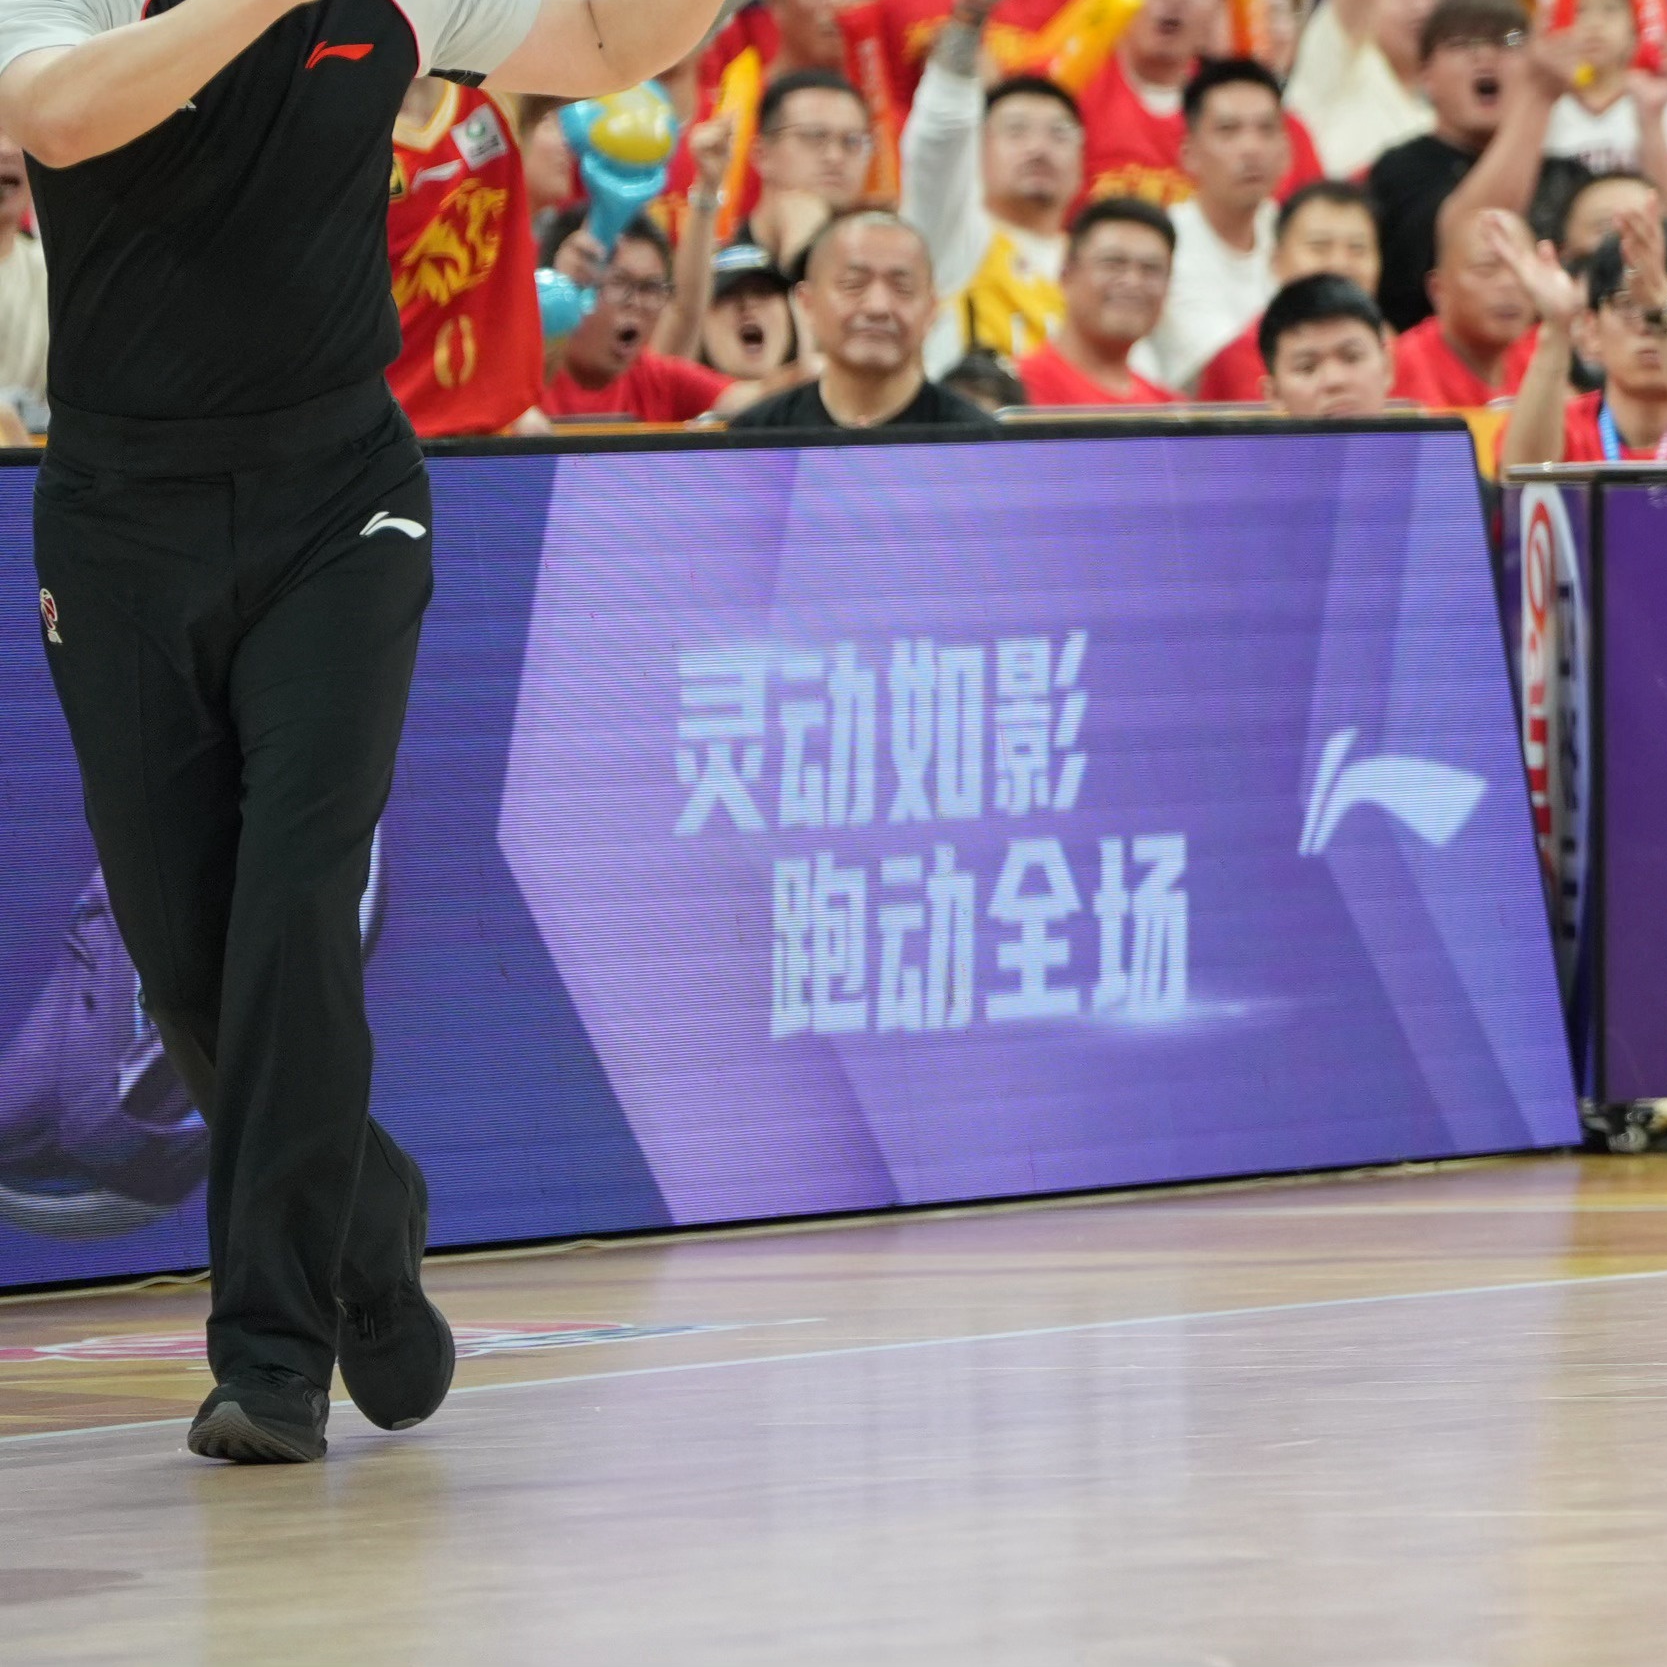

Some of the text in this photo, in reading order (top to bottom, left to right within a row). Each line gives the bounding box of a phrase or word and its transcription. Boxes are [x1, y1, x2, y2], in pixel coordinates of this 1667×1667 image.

[673, 632, 1087, 834] 灵动如影
[771, 836, 1189, 1037] 跑动全场
